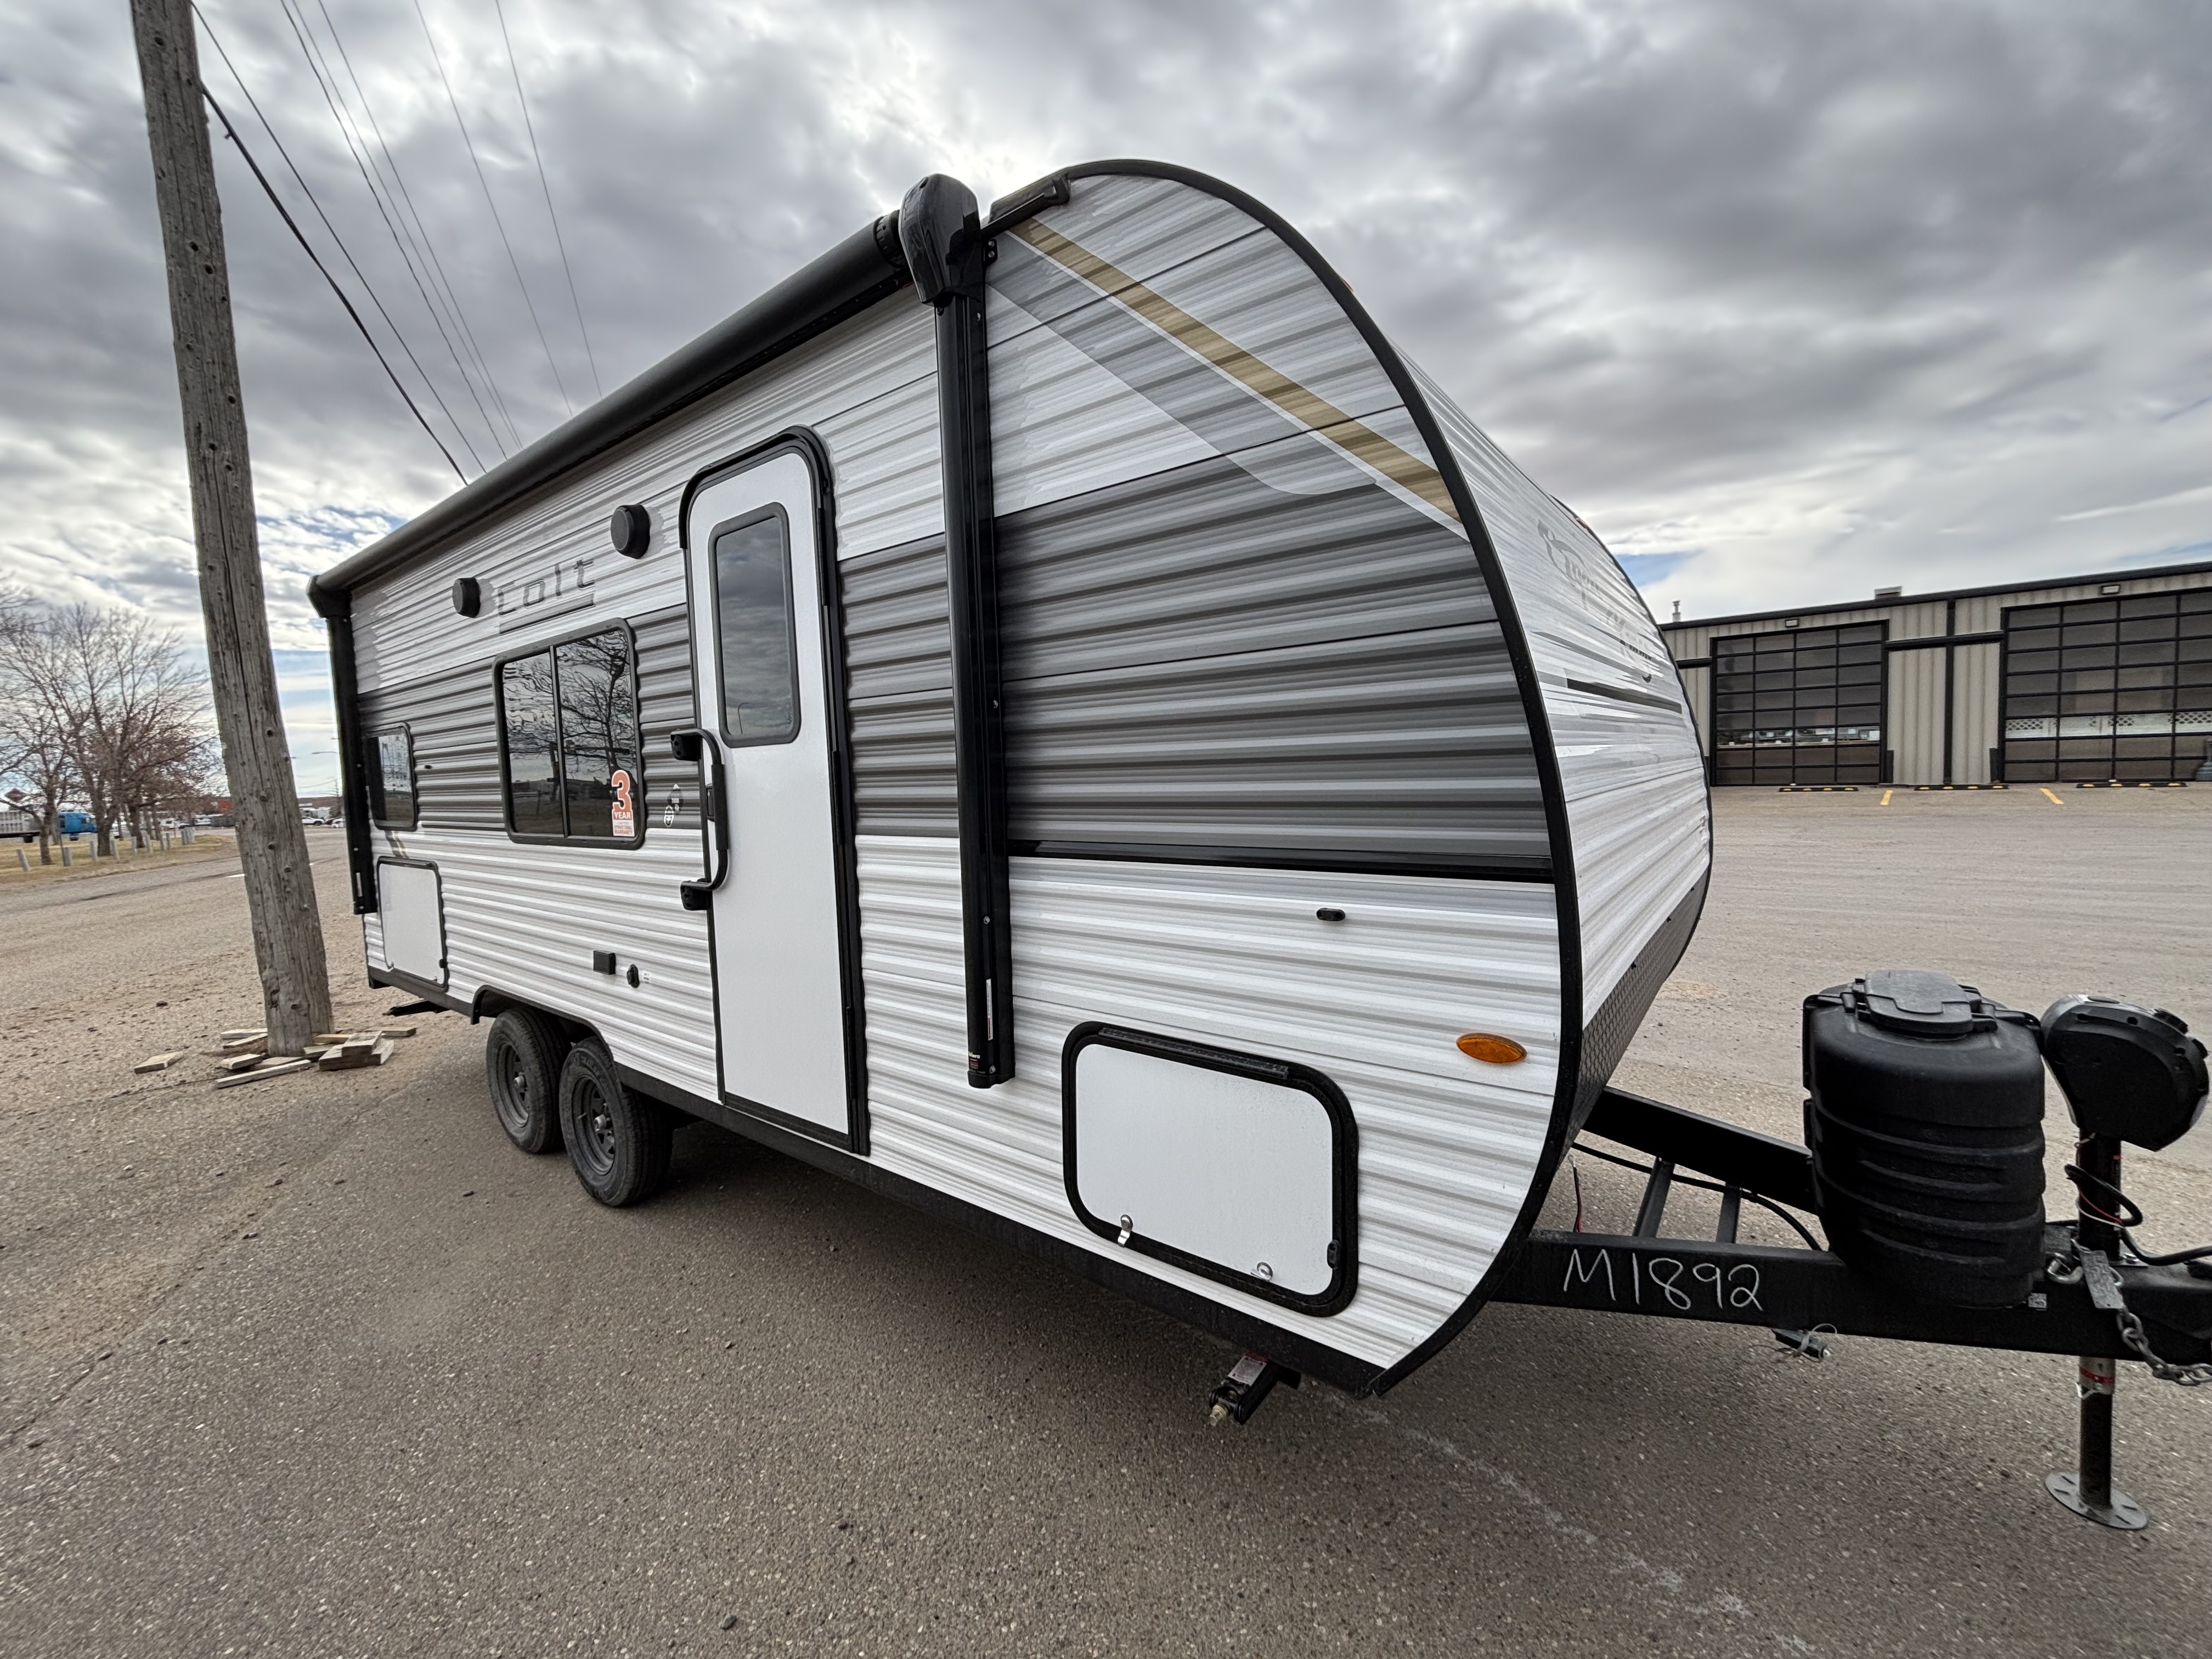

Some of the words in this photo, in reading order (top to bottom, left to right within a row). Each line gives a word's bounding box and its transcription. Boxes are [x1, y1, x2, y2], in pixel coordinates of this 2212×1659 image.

[498, 558, 595, 616] Colt
[611, 769, 632, 812] 3
[614, 811, 631, 820] YEAR
[1563, 1248, 1764, 1312] M1892
